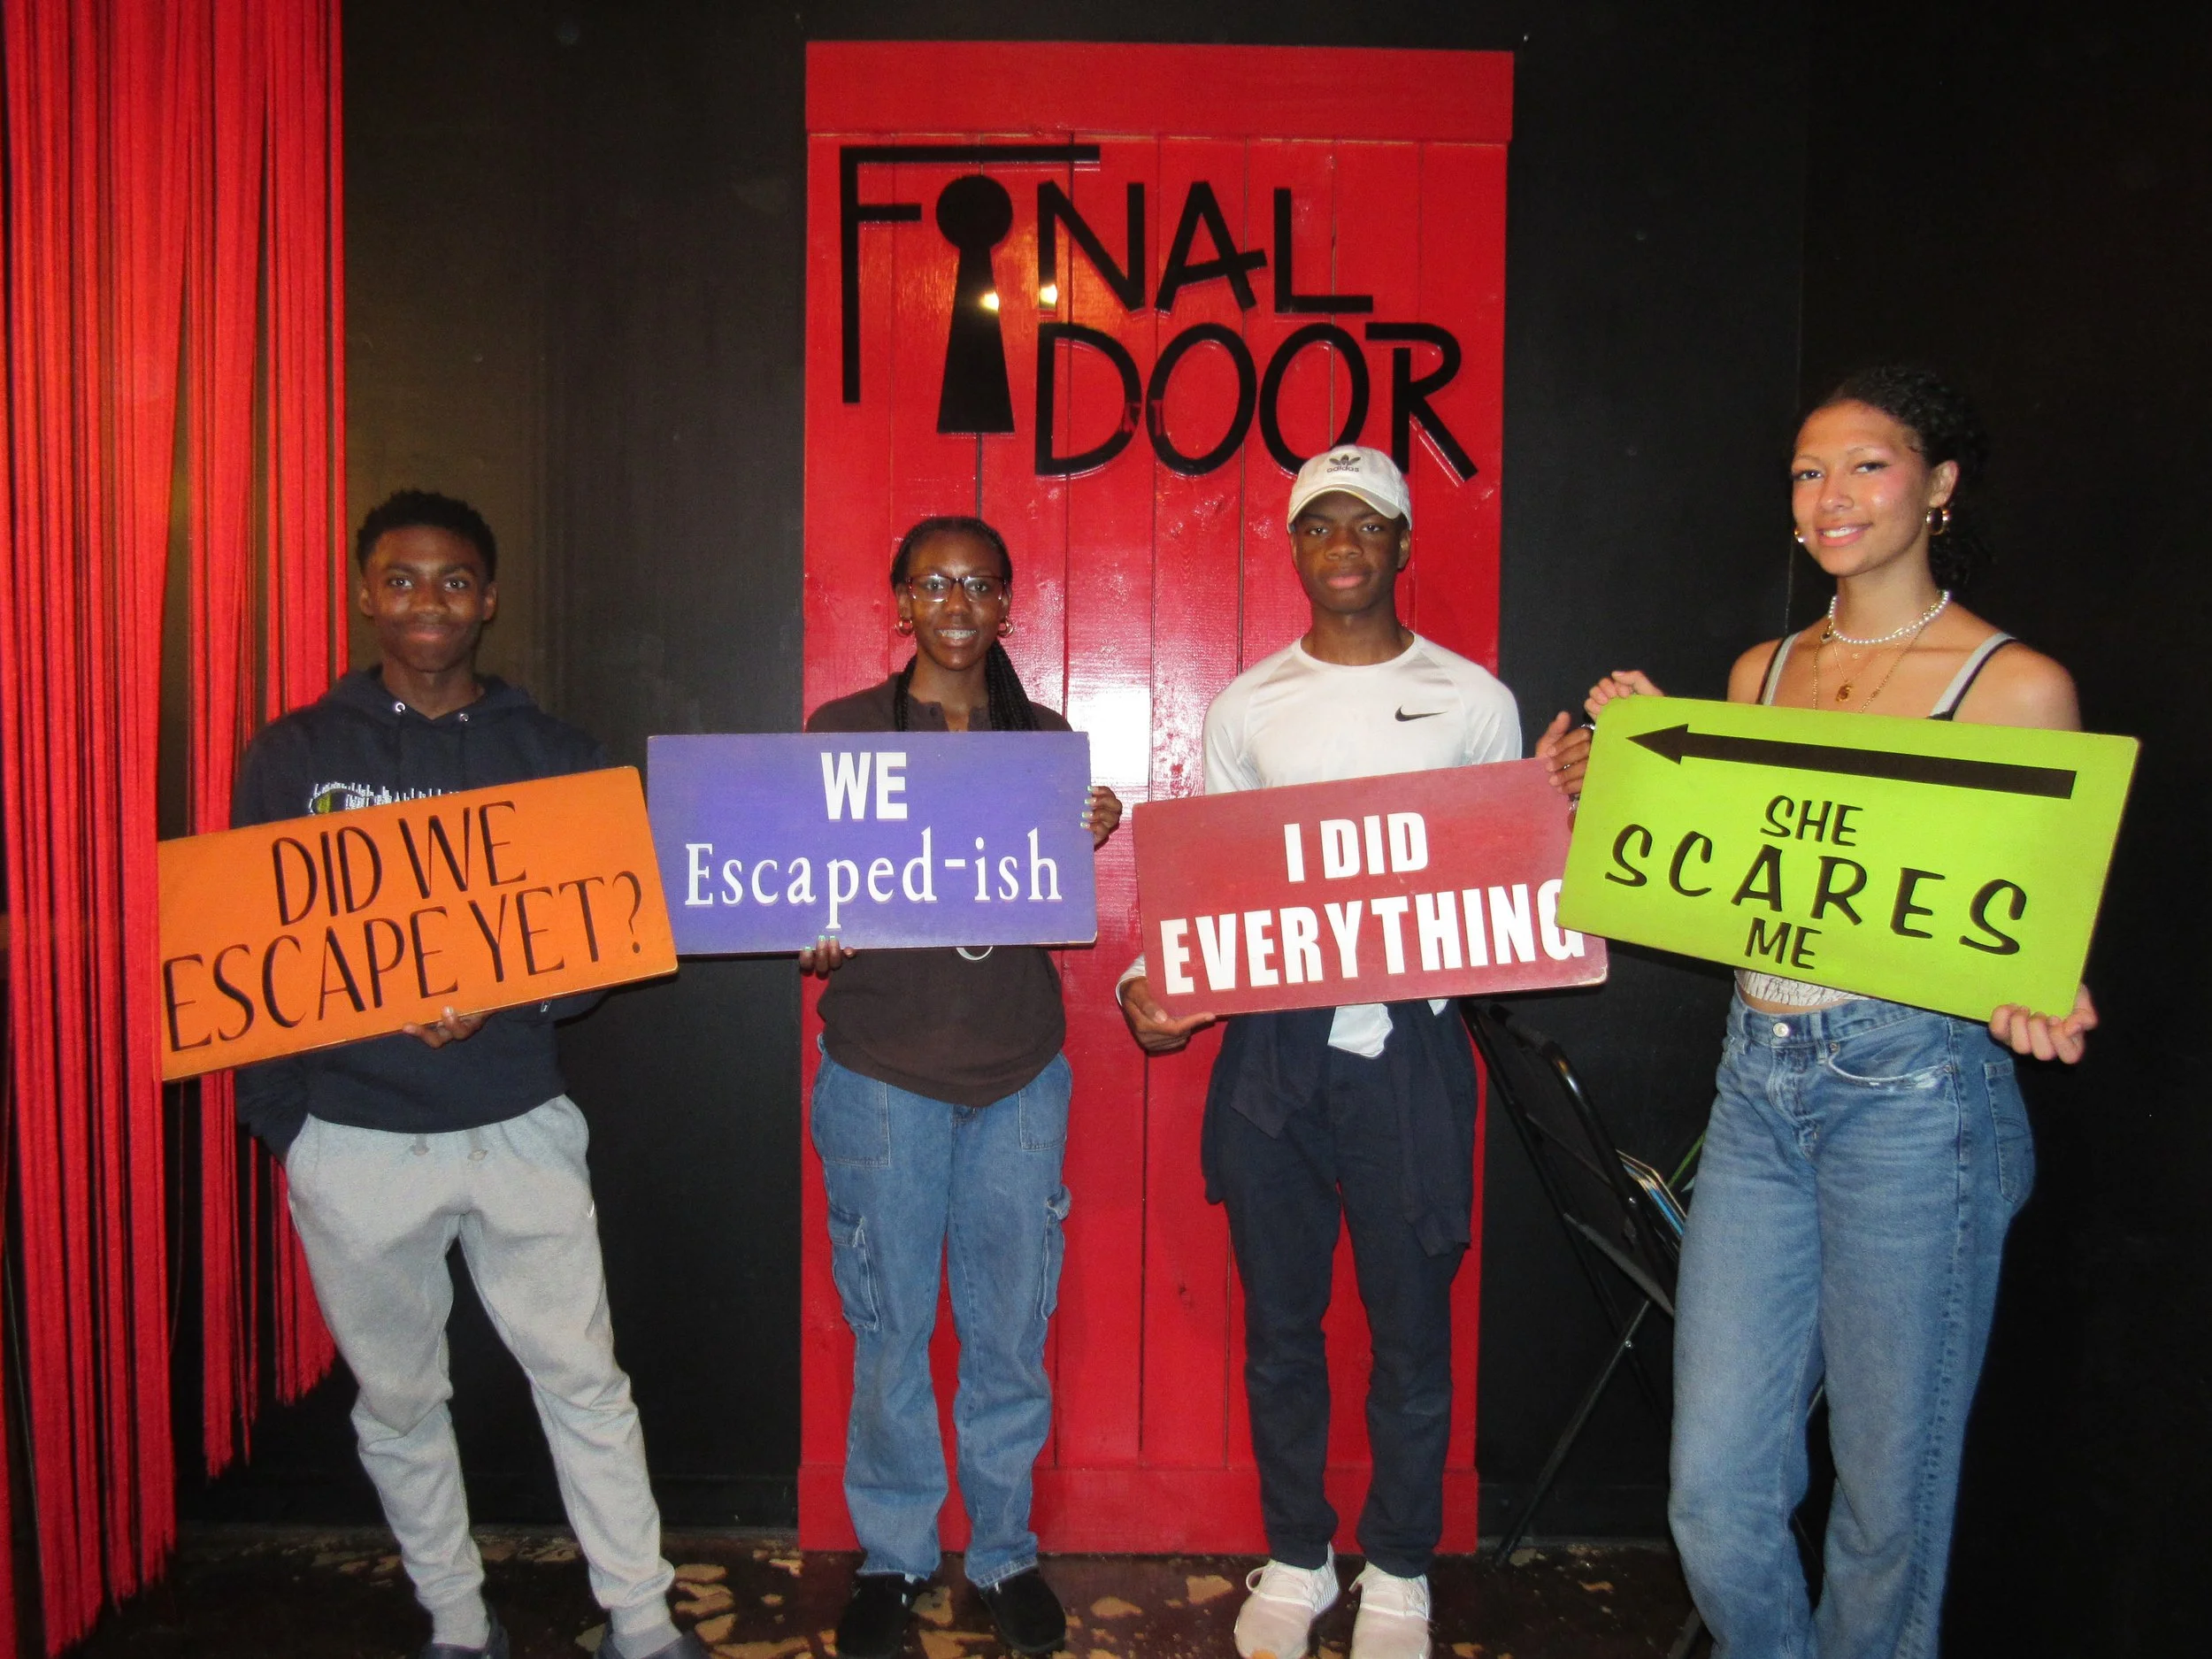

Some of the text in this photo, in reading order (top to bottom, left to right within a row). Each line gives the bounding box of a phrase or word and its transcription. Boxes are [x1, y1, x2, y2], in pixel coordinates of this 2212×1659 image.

[840, 144, 1374, 434] FINAL
[1034, 321, 1479, 484] DOOR
[821, 752, 908, 820] WE
[1760, 795, 1863, 847] SHE
[271, 800, 527, 926] DID WE
[685, 826, 1063, 930] Escaped-ish
[1283, 811, 1429, 883] I DID
[1604, 824, 2028, 956] SCARES
[162, 870, 643, 1052] ESCAPE YET?
[1160, 879, 1586, 996] EVERYTHING
[1744, 918, 1823, 970] ME
